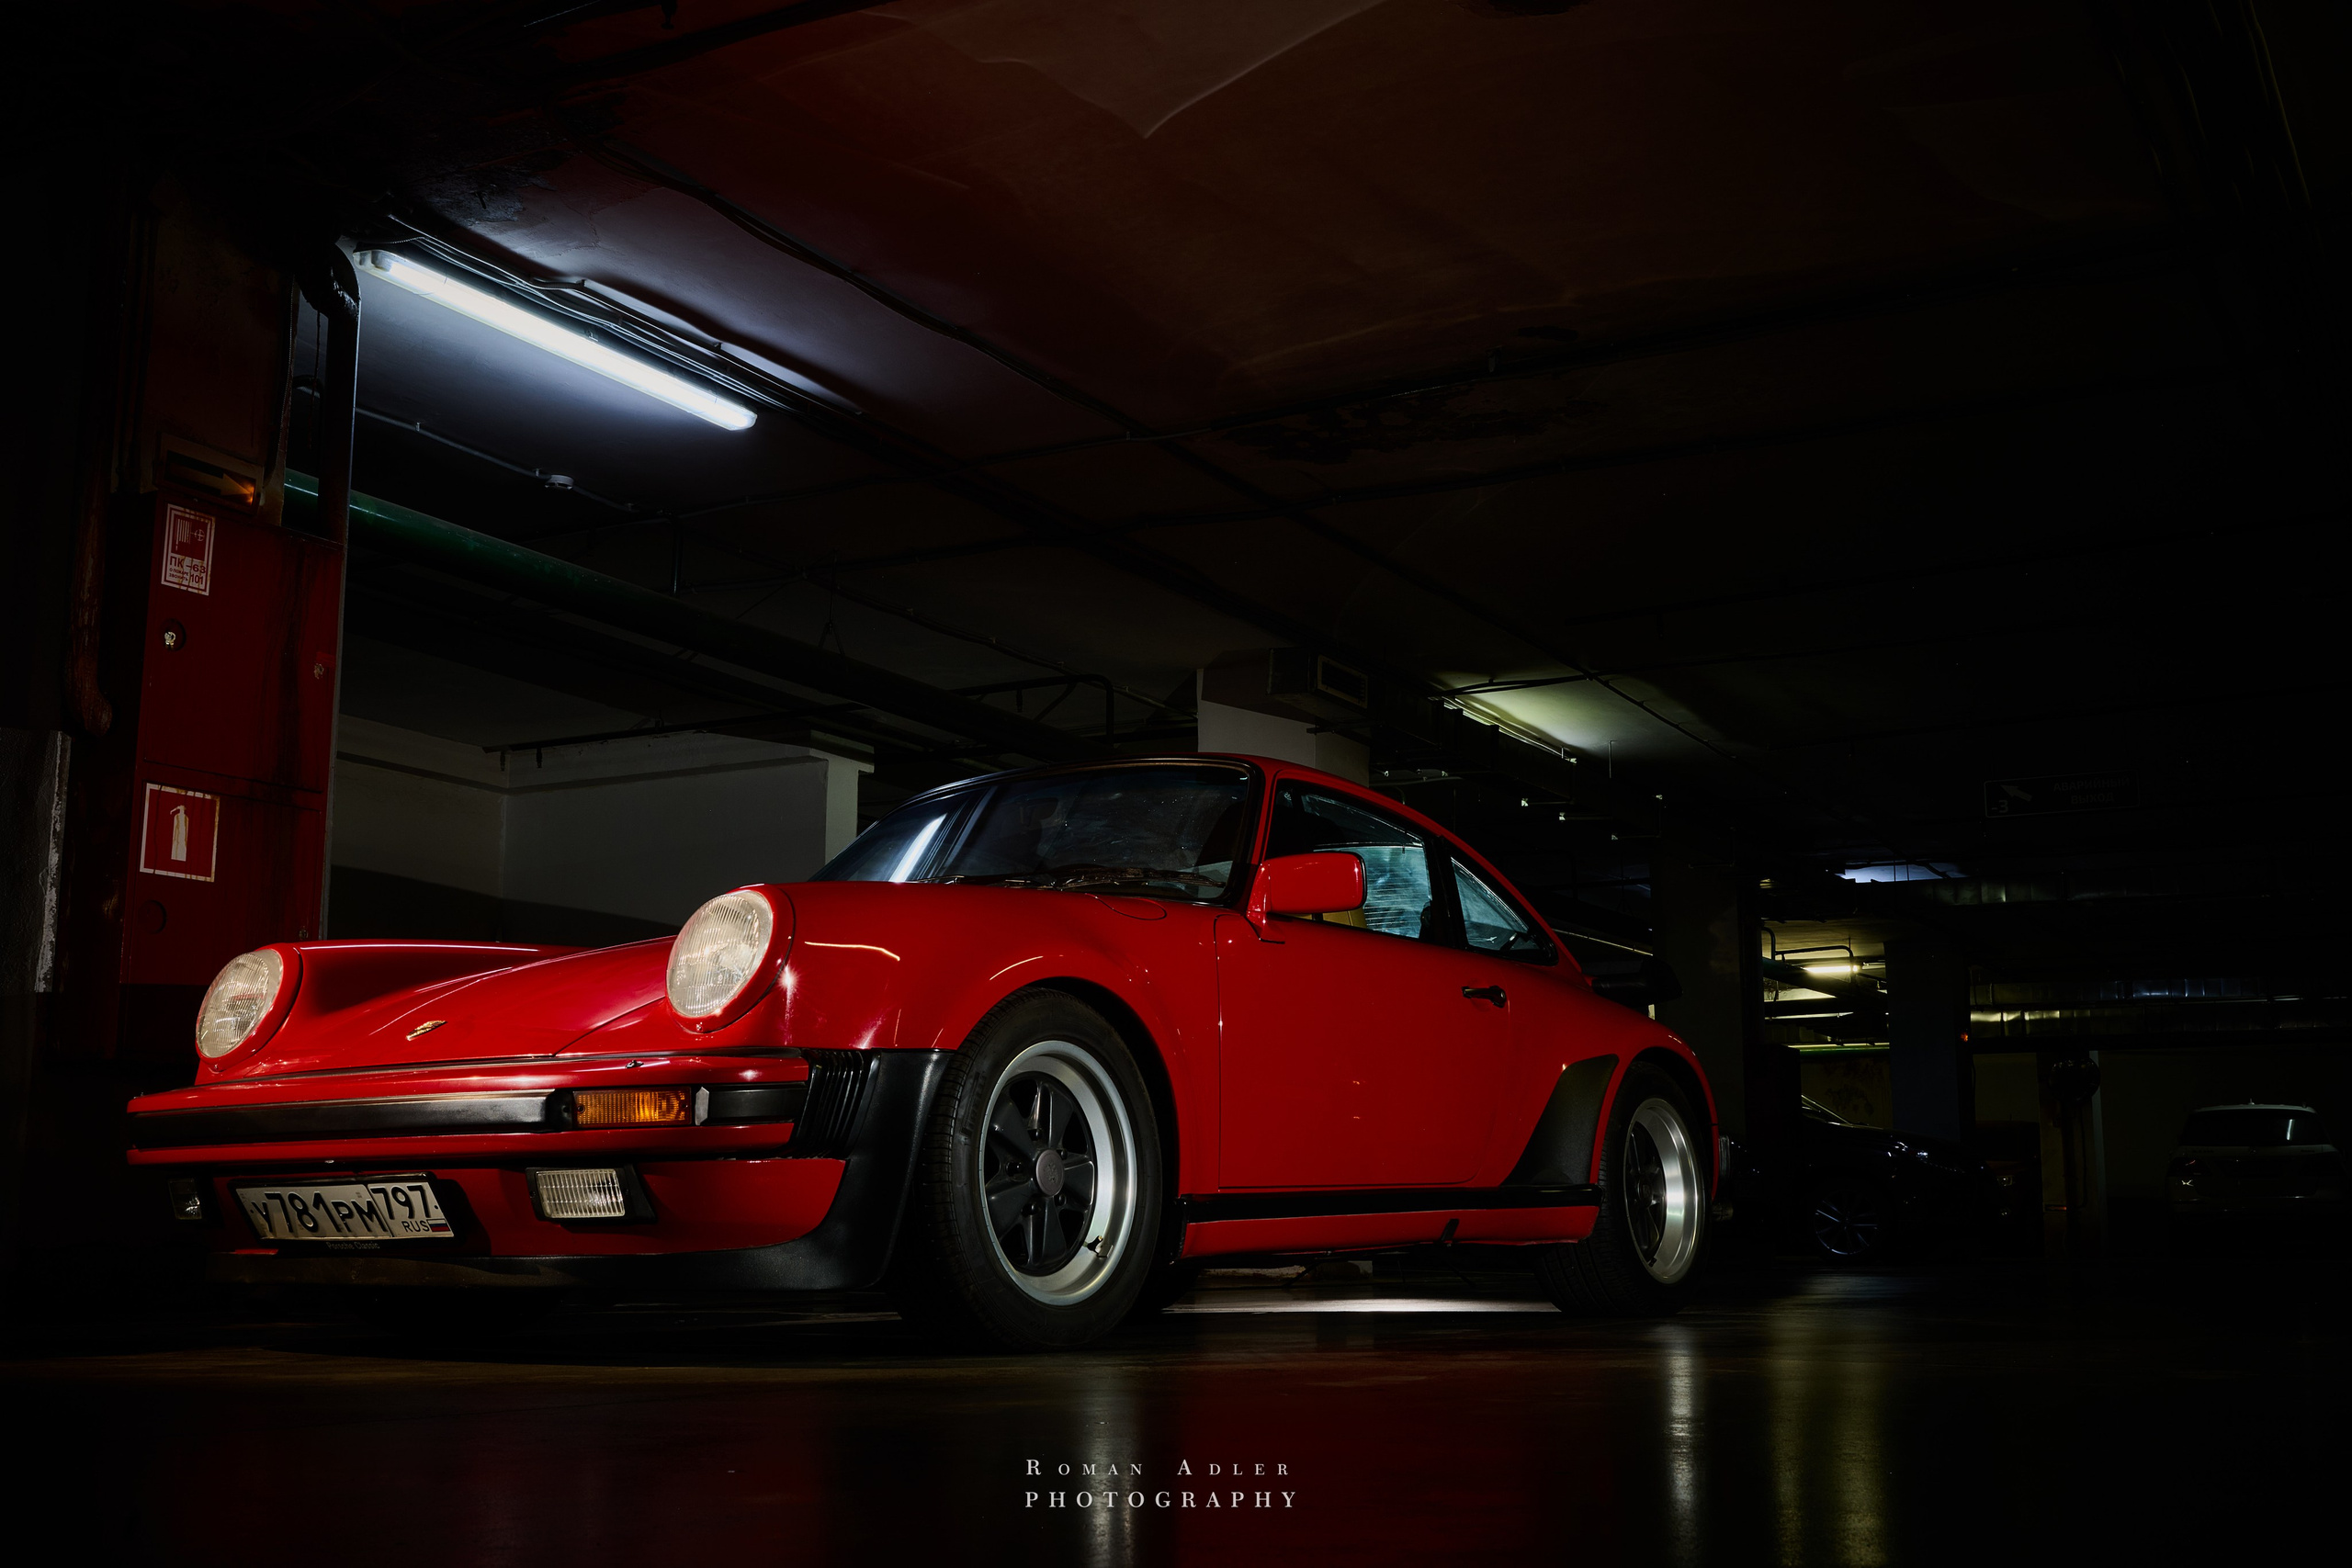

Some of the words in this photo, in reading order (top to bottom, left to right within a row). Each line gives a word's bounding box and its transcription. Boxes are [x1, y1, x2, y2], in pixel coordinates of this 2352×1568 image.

[190, 573, 204, 585] 101
[370, 1185, 431, 1220] 797
[401, 1220, 430, 1233] RUS
[325, 1241, 355, 1249] Porsche
[355, 1241, 380, 1249] Classic
